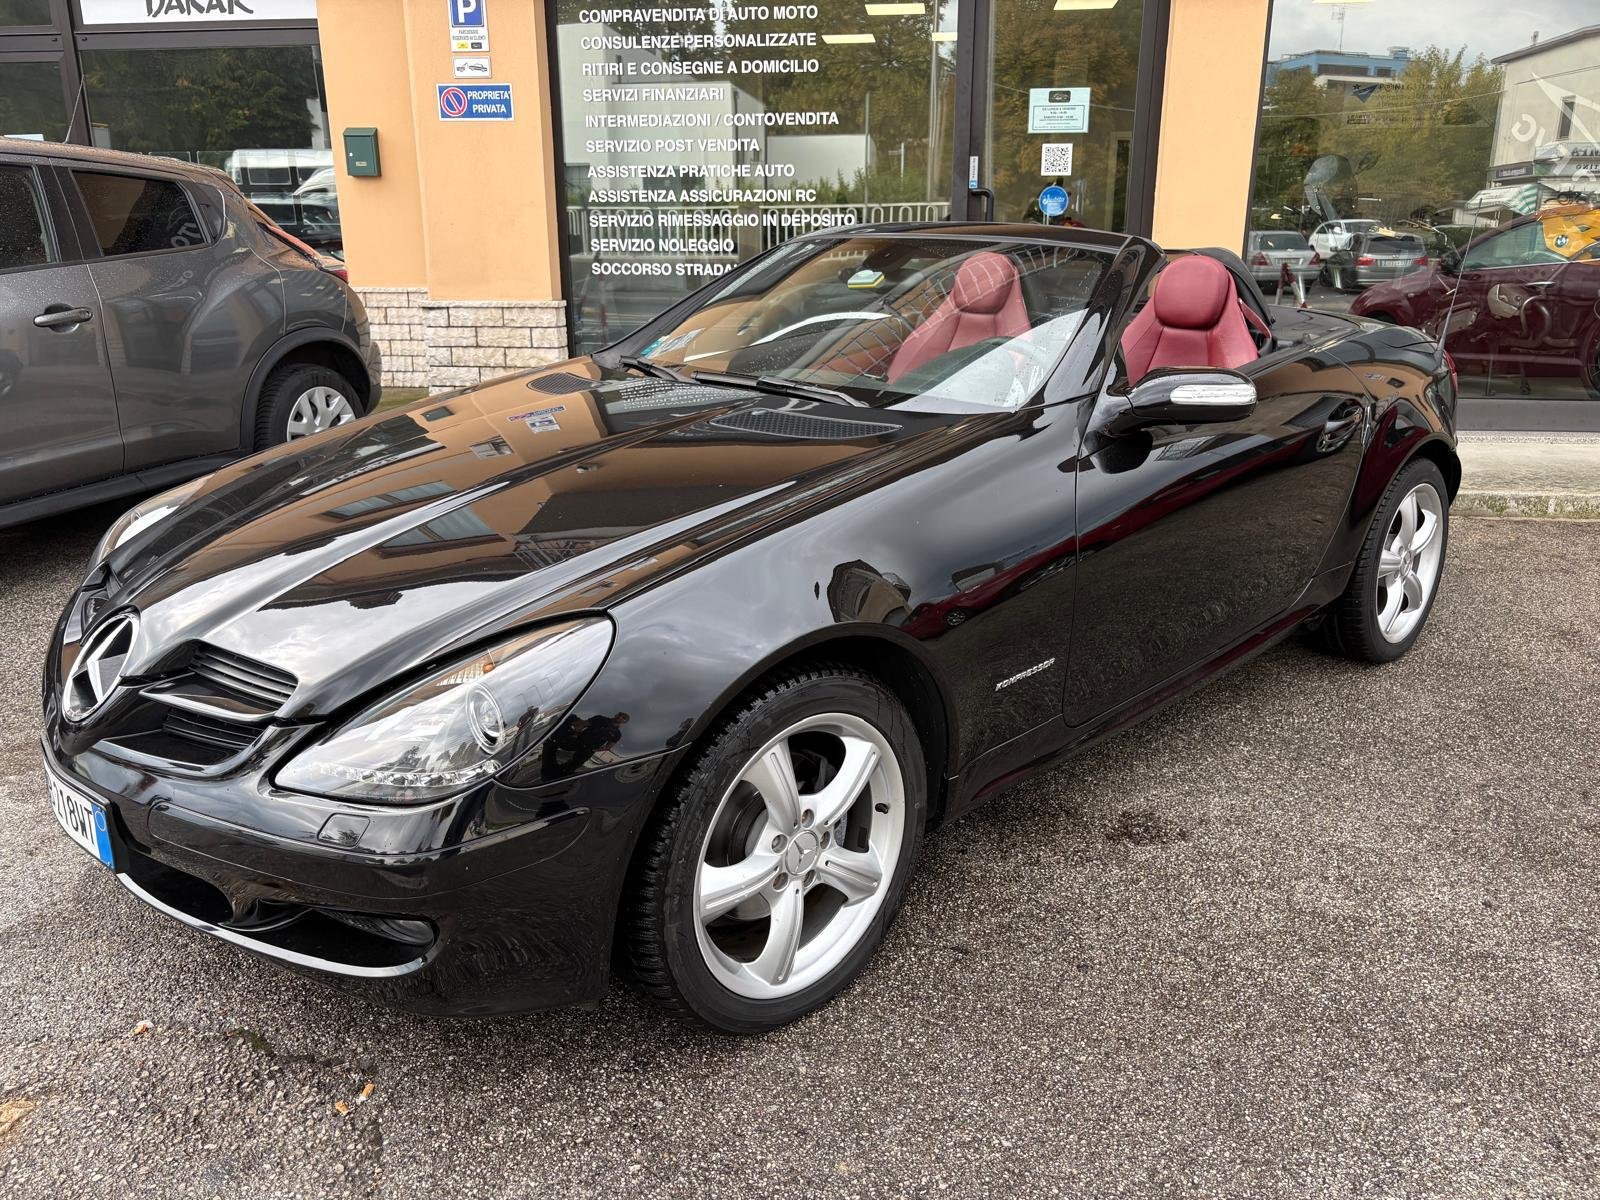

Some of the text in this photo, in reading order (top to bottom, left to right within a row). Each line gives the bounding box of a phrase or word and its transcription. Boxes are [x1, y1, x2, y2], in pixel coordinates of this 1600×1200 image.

[457, 0, 477, 23] P
[579, 5, 818, 23] COMPRAVENDITA DI AUTO MOTO
[581, 33, 817, 50] CONSULENZE PERSONALIZZATE
[582, 59, 819, 76] RITIRI E CONSEGNE A DOMICILIO
[583, 87, 724, 102] SERVIZI FINANZIARI
[473, 104, 506, 113] PRIVATA
[585, 112, 839, 128] INTERMEDIAZIONI / CONTOVENDITA
[586, 138, 760, 153] SERVIZIO POST VENDITA
[587, 163, 795, 179] ASSISTENZA PRATICHE AUTO
[588, 189, 817, 203] ASSISTENZA ASSICURAZIONI RC
[589, 213, 856, 228] SERVIZIO RIMESSAGGIO IN DEPOSITO
[590, 238, 734, 252] SERVIZIO NOLEGGIO
[591, 263, 738, 277] SOCCORSO STRADA
